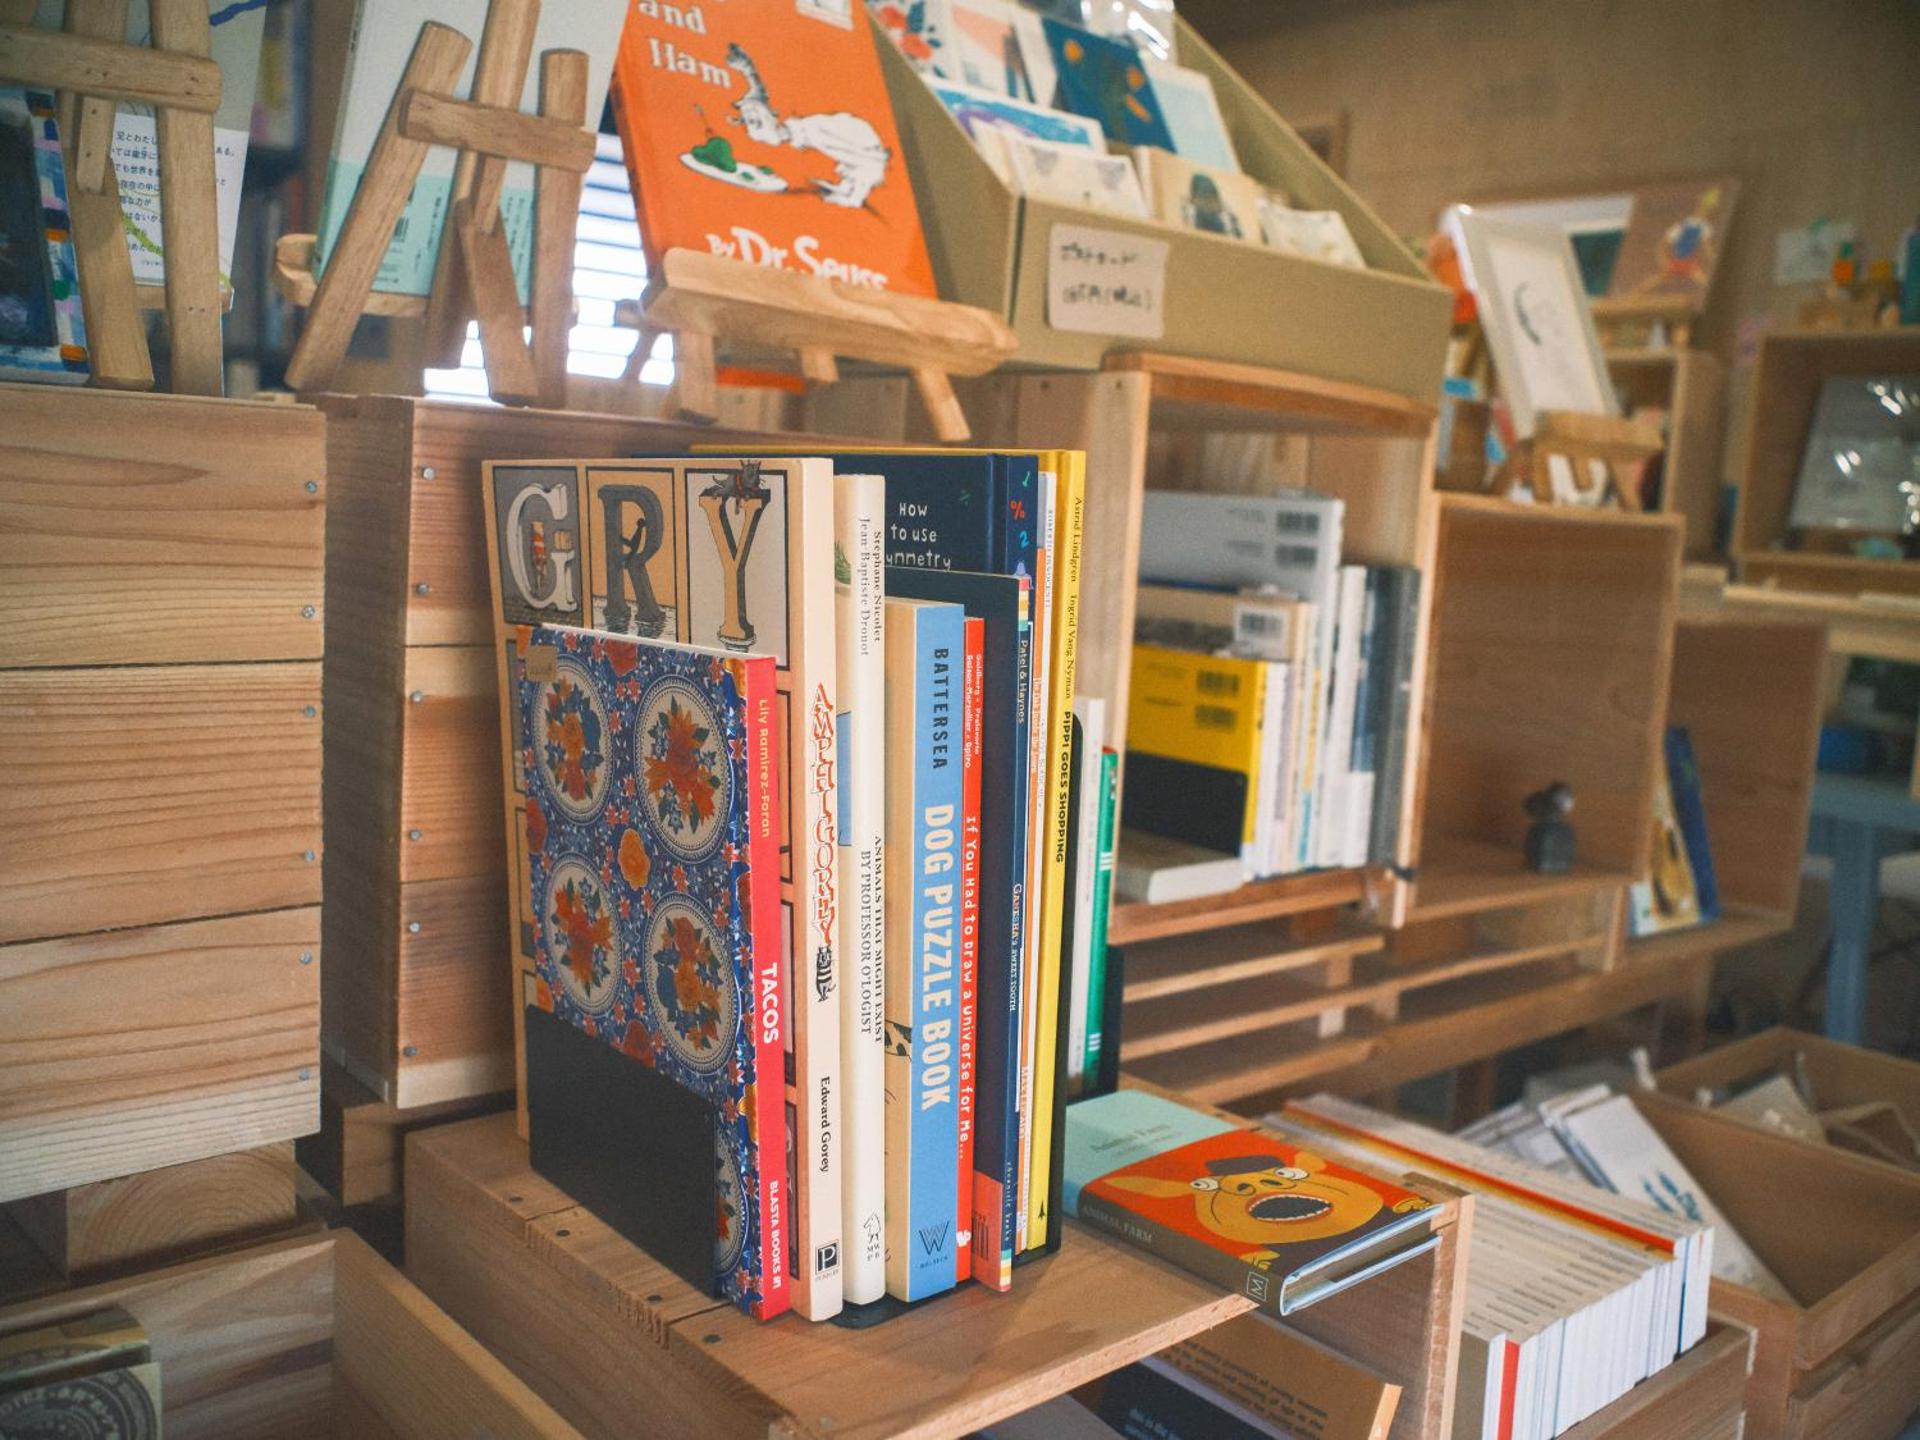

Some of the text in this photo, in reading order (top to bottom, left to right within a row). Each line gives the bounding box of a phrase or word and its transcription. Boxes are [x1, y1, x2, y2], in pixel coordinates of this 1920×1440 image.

[638, 0, 707, 35] and
[647, 37, 731, 89] Ham
[705, 233, 736, 260] By
[890, 523, 937, 543] to use
[1070, 496, 1083, 582] Astrid Lindgren
[1064, 594, 1078, 700] Ingrid Vang Nyman
[1017, 639, 1029, 724] Patel & Haynes
[932, 648, 949, 769] BATTERSEA
[758, 699, 772, 839] Lily Ramirez-Foran
[1056, 711, 1071, 864] PIPPI GOES SHOPPING
[966, 816, 977, 834] If
[860, 850, 871, 870] BY
[965, 839, 977, 872] You
[965, 877, 977, 909] Had
[860, 873, 872, 962] PROFESSOR
[875, 835, 885, 1044] ANIMALS THAT MIGHT EXIST
[964, 915, 975, 935] to
[920, 804, 955, 1111] DOG PUZZLE BOOK
[761, 962, 779, 1045] TACOS
[962, 989, 972, 1000] a
[960, 1085, 973, 1113] for
[818, 1076, 832, 1173] Edward Gorey
[769, 1180, 780, 1228] BLASTA
[770, 1230, 782, 1275] BOOKS
[1122, 1220, 1153, 1244] FARM
